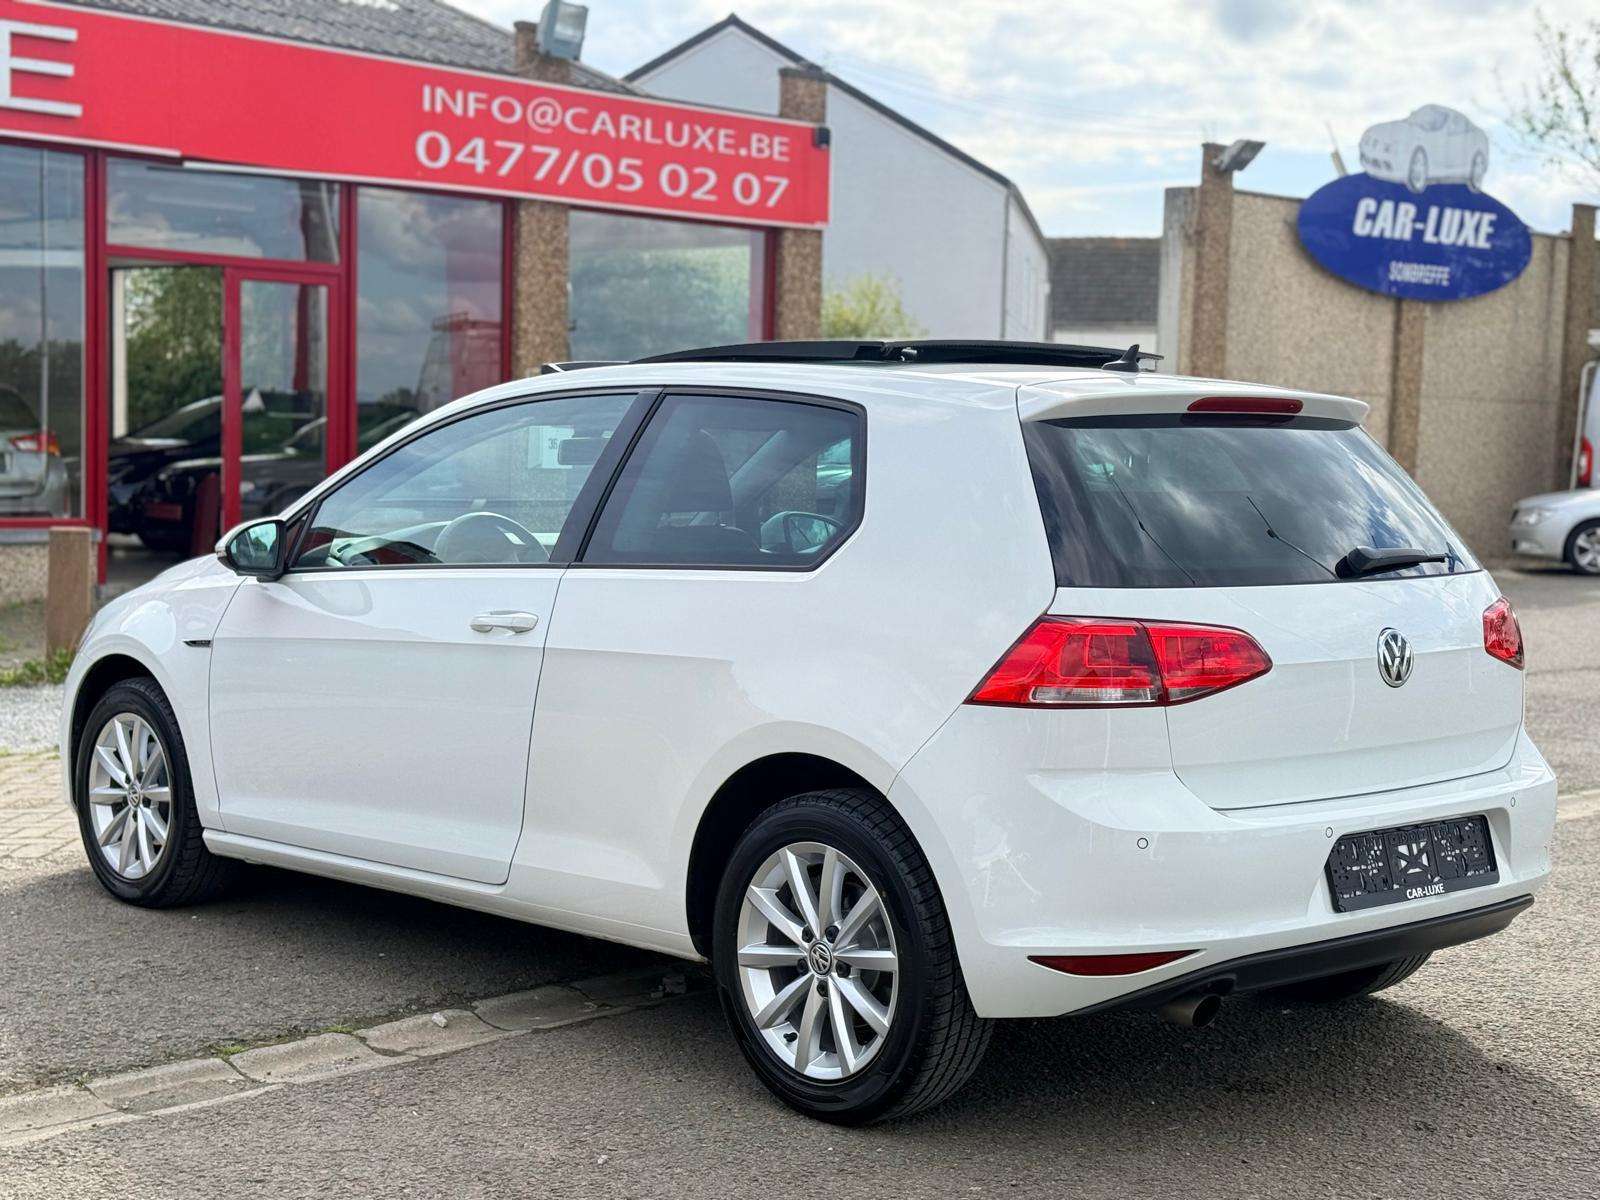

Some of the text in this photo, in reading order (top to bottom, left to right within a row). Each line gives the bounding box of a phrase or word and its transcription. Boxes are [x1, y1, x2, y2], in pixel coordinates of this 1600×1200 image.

[422, 84, 790, 162] INFO@CARLUXE.BE
[415, 130, 790, 208] 0477/05 02 07
[1353, 197, 1497, 249] CAR-LUXE
[1406, 883, 1445, 899] CAR-LUXE
